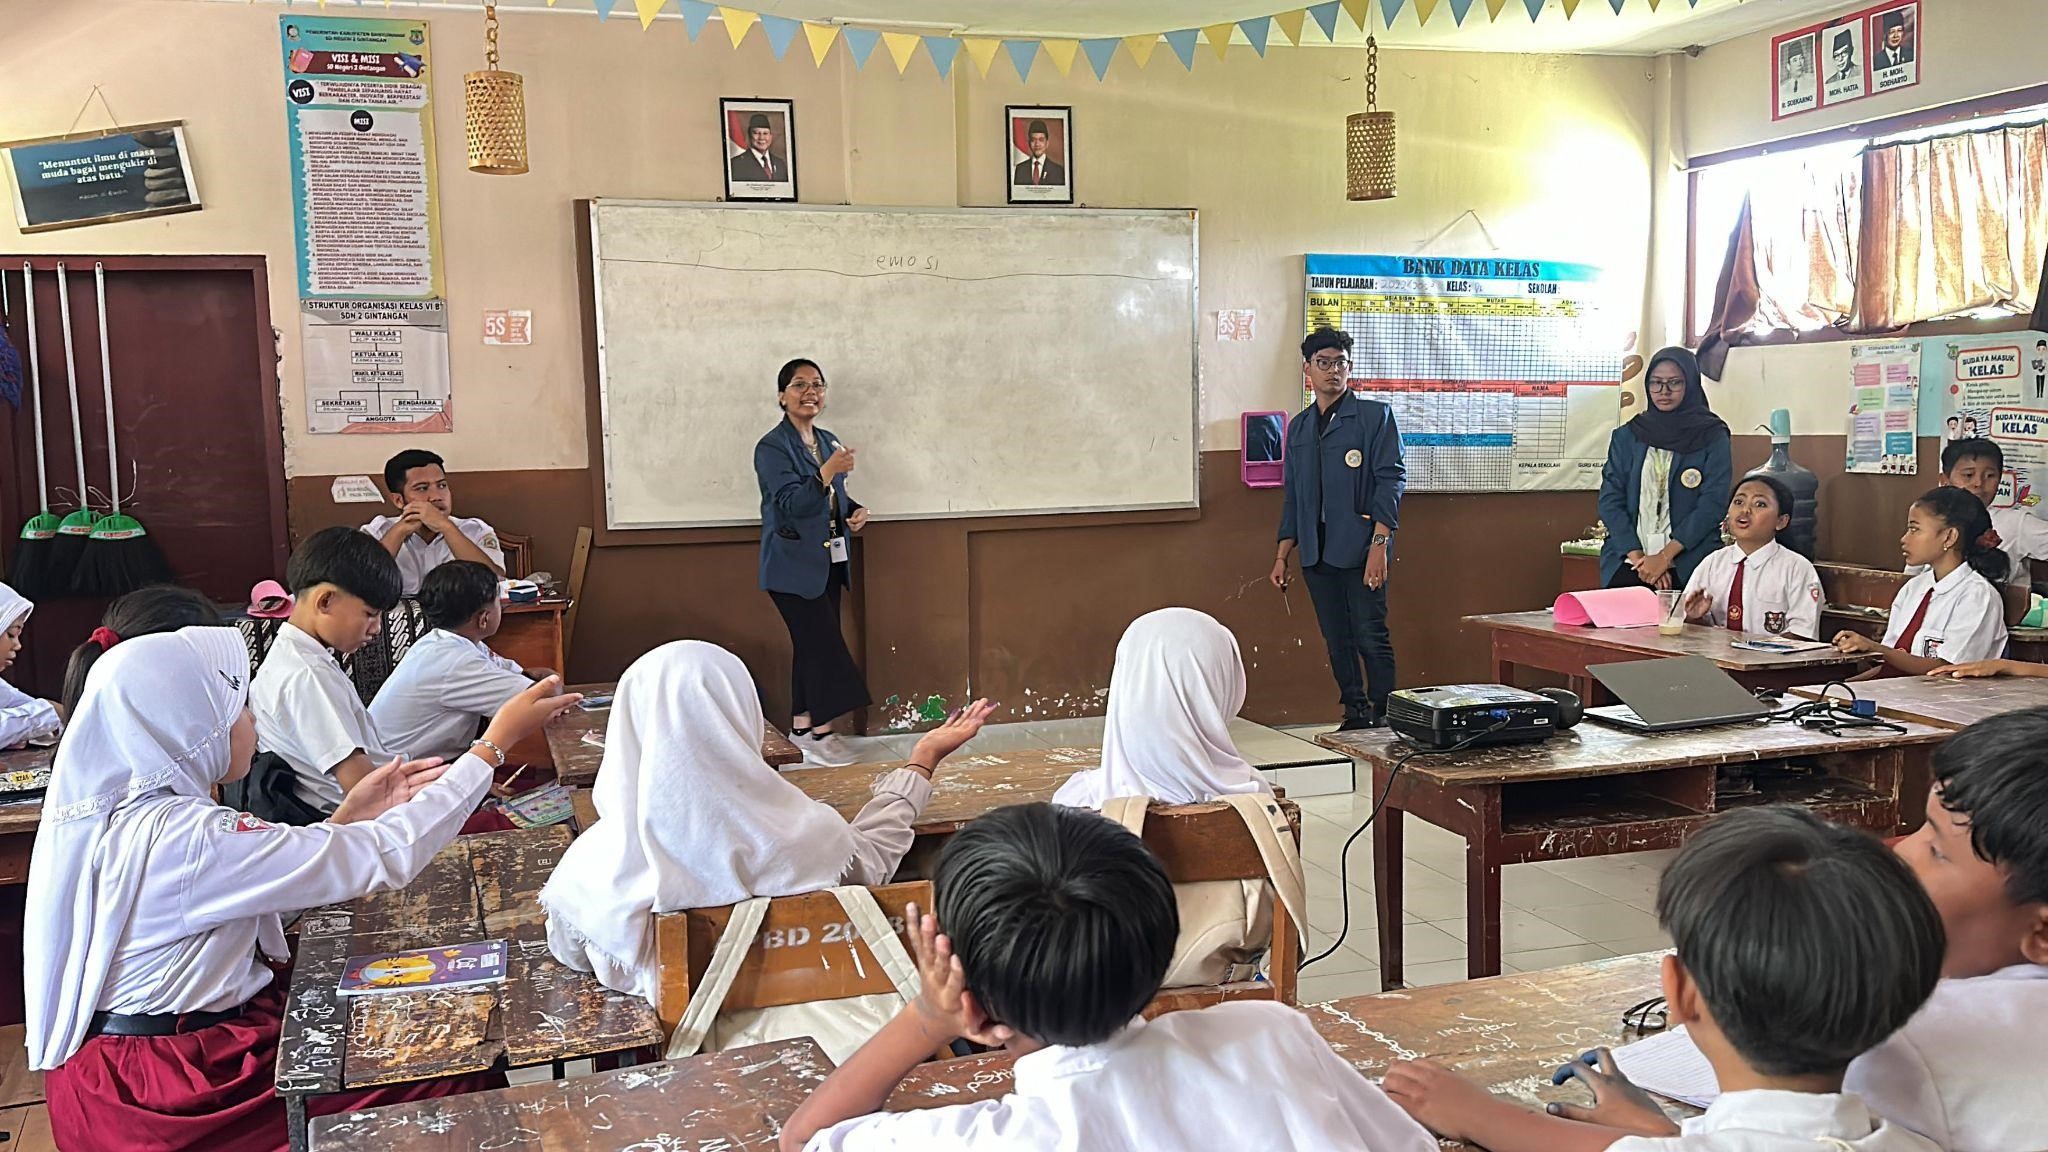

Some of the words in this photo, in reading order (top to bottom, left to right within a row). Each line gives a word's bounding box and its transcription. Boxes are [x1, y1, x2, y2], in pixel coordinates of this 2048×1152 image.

[331, 53, 349, 63] VISI
[351, 54, 358, 63] &
[360, 55, 380, 64] MISI
[292, 87, 310, 98] VISI
[94, 154, 116, 162] ilmu
[118, 151, 128, 159] di
[130, 149, 155, 158] masa
[41, 168, 69, 179] muda
[71, 165, 96, 176] bagai
[99, 158, 145, 172] mengukir
[148, 156, 157, 165] di
[77, 175, 97, 184] atas
[1403, 259, 1445, 274] BANK
[1451, 260, 1489, 275] DATA
[1495, 261, 1540, 277] KELAS
[1311, 277, 1334, 289] TAHUN
[1310, 298, 1338, 306] BULAN
[486, 317, 505, 336] 5S
[1962, 355, 1990, 365] BUDAYA
[1970, 365, 2004, 377] KELAS
[2002, 423, 2037, 434] KELAS
